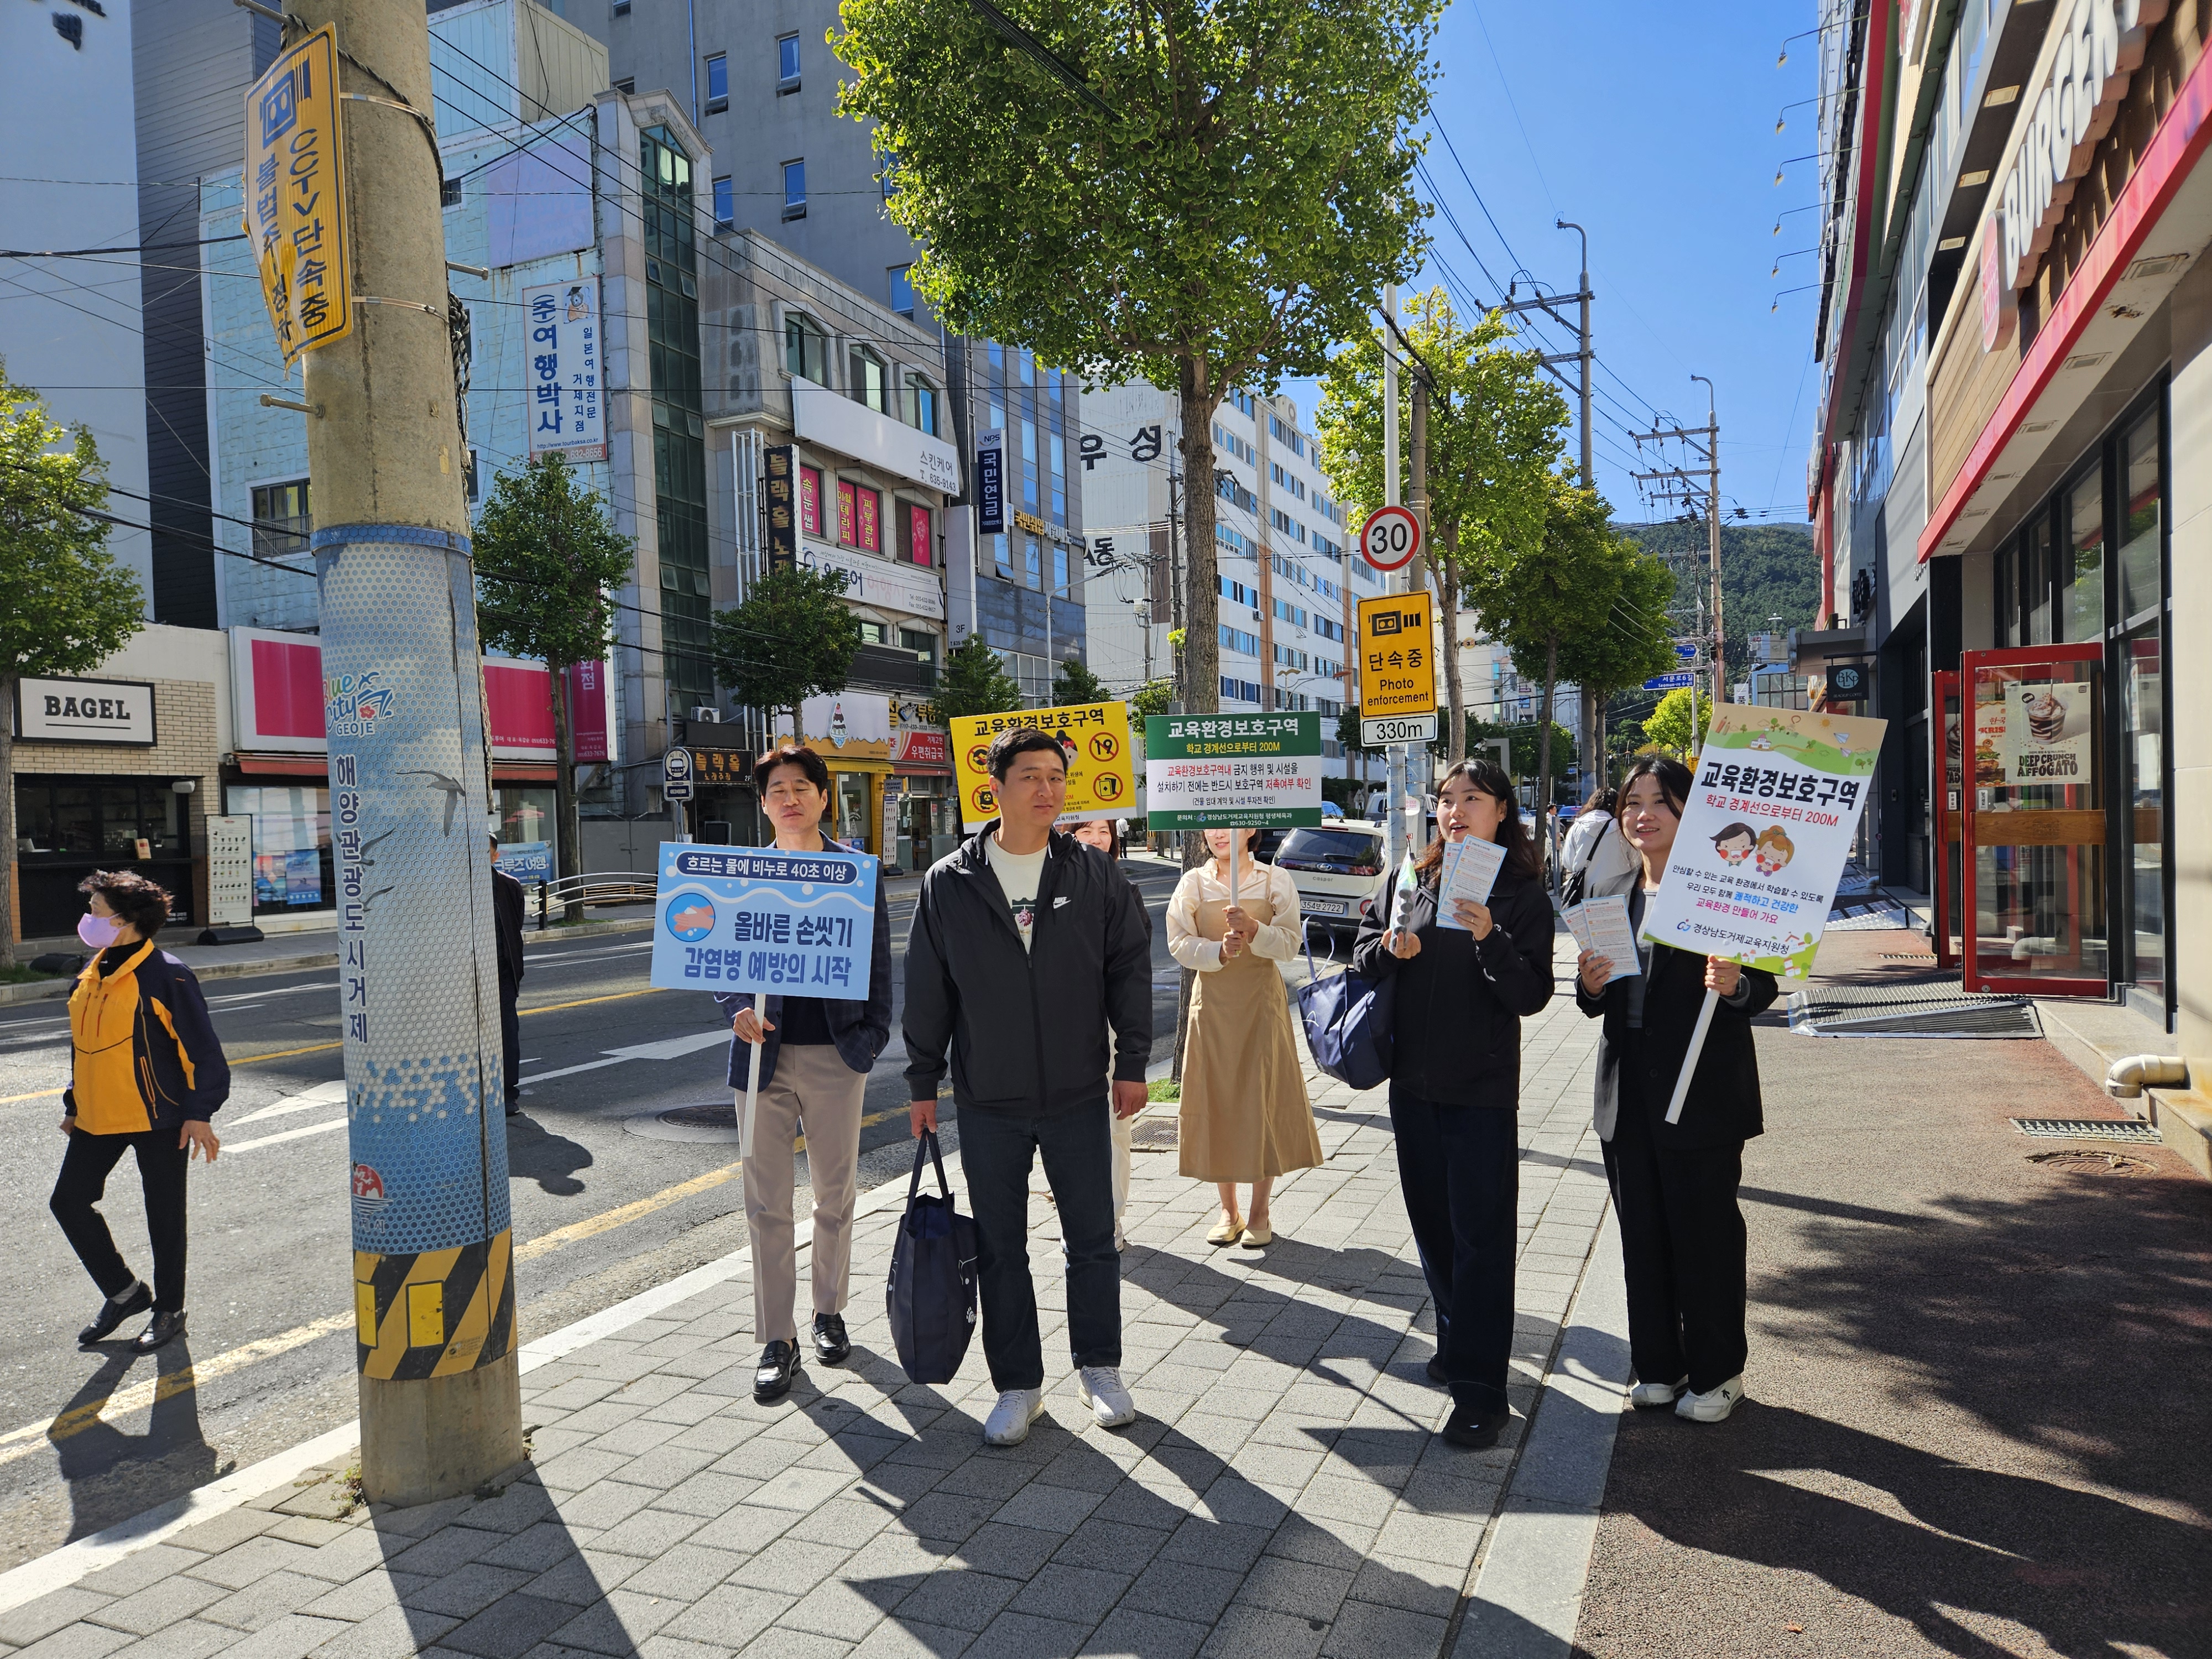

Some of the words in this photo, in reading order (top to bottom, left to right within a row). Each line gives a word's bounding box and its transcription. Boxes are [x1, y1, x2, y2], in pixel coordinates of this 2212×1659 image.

[573, 373, 585, 432] 거제지점
[570, 447, 602, 460] 632-8656
[920, 451, 953, 476] 스킨케어
[930, 473, 956, 492] 635-9143
[984, 452, 998, 516] 국민연금
[802, 478, 813, 530] 속눈썹
[864, 499, 874, 547] 피부관리
[1371, 523, 1407, 554] 30
[956, 624, 965, 633] 3F
[1369, 648, 1423, 672] 단속중
[1380, 678, 1414, 691] Photo
[1662, 674, 1693, 682] 서문로6길
[45, 695, 131, 720] BAGEL
[1368, 691, 1428, 707] enforcement
[336, 722, 374, 736] GEOJE
[1168, 718, 1298, 738] 교육환경보호구역
[1376, 721, 1422, 740] 330m
[912, 746, 943, 759] 우편취급국
[1186, 743, 1202, 754] 학교
[1203, 742, 1257, 754] 경계선으로부터
[1259, 742, 1280, 752] 200M
[695, 753, 740, 771] 블랙홀
[1167, 765, 1231, 777] 교육환경보호구역내
[1233, 764, 1248, 776] 금지
[1250, 763, 1265, 775] 행위
[1267, 764, 1274, 775] 및
[1276, 762, 1298, 775] 시설을
[2017, 759, 2078, 777] AFFOGATO
[2019, 755, 2039, 767] DEEP
[2041, 753, 2077, 764] CRUNCH
[1157, 781, 1185, 792] 설치하기
[1187, 780, 1209, 792] 전에는
[1211, 779, 1232, 791] 반드시
[1234, 779, 1263, 790] 보호구역
[1265, 778, 1295, 790] 저촉여부
[1296, 778, 1311, 790] 확인
[1700, 761, 1860, 811] 교육환경보호구역
[1192, 797, 1204, 806] (건물
[1206, 797, 1215, 806] 임대
[1217, 796, 1227, 805] 계약
[1235, 796, 1245, 805] 시설
[1247, 796, 1262, 805] 투자전
[1263, 796, 1275, 805] 확인)
[1706, 794, 1726, 808] 학교
[1729, 798, 1803, 822] 경계선으로부터
[1805, 811, 1839, 827] 200M
[1207, 813, 1264, 821] 경상남도거제교육지원청
[525, 855, 546, 870] 여행
[686, 855, 723, 873] 흐르는
[726, 859, 749, 875] 물에
[753, 860, 787, 877] 비누로
[791, 863, 820, 878] 40초
[823, 864, 847, 881] 이상
[1672, 865, 1694, 876] 안심할
[1695, 869, 1702, 878] 수
[1704, 872, 1718, 881] 있는
[1719, 874, 1734, 885] 교육
[1736, 878, 1765, 891] 환경에서
[1767, 884, 1790, 897] 학습할
[1791, 889, 1798, 898] 수
[1800, 891, 1824, 904] 있도록
[1687, 882, 1701, 892] 우리
[1702, 885, 1717, 897] 모두
[1718, 889, 1733, 900] 함께
[1734, 891, 1770, 907] 쾌적하고
[1771, 899, 1799, 914] 건강한
[1696, 898, 1730, 914] 교육환경
[1733, 905, 1759, 920] 만들어
[1760, 911, 1779, 925] 가요
[734, 911, 791, 944] 올바른
[796, 915, 853, 947] 손씻기
[1693, 923, 1791, 956] 경상남도거제교육지원청
[684, 947, 742, 981] 감염병
[748, 951, 806, 984] 예방의
[811, 954, 852, 987] 시작
